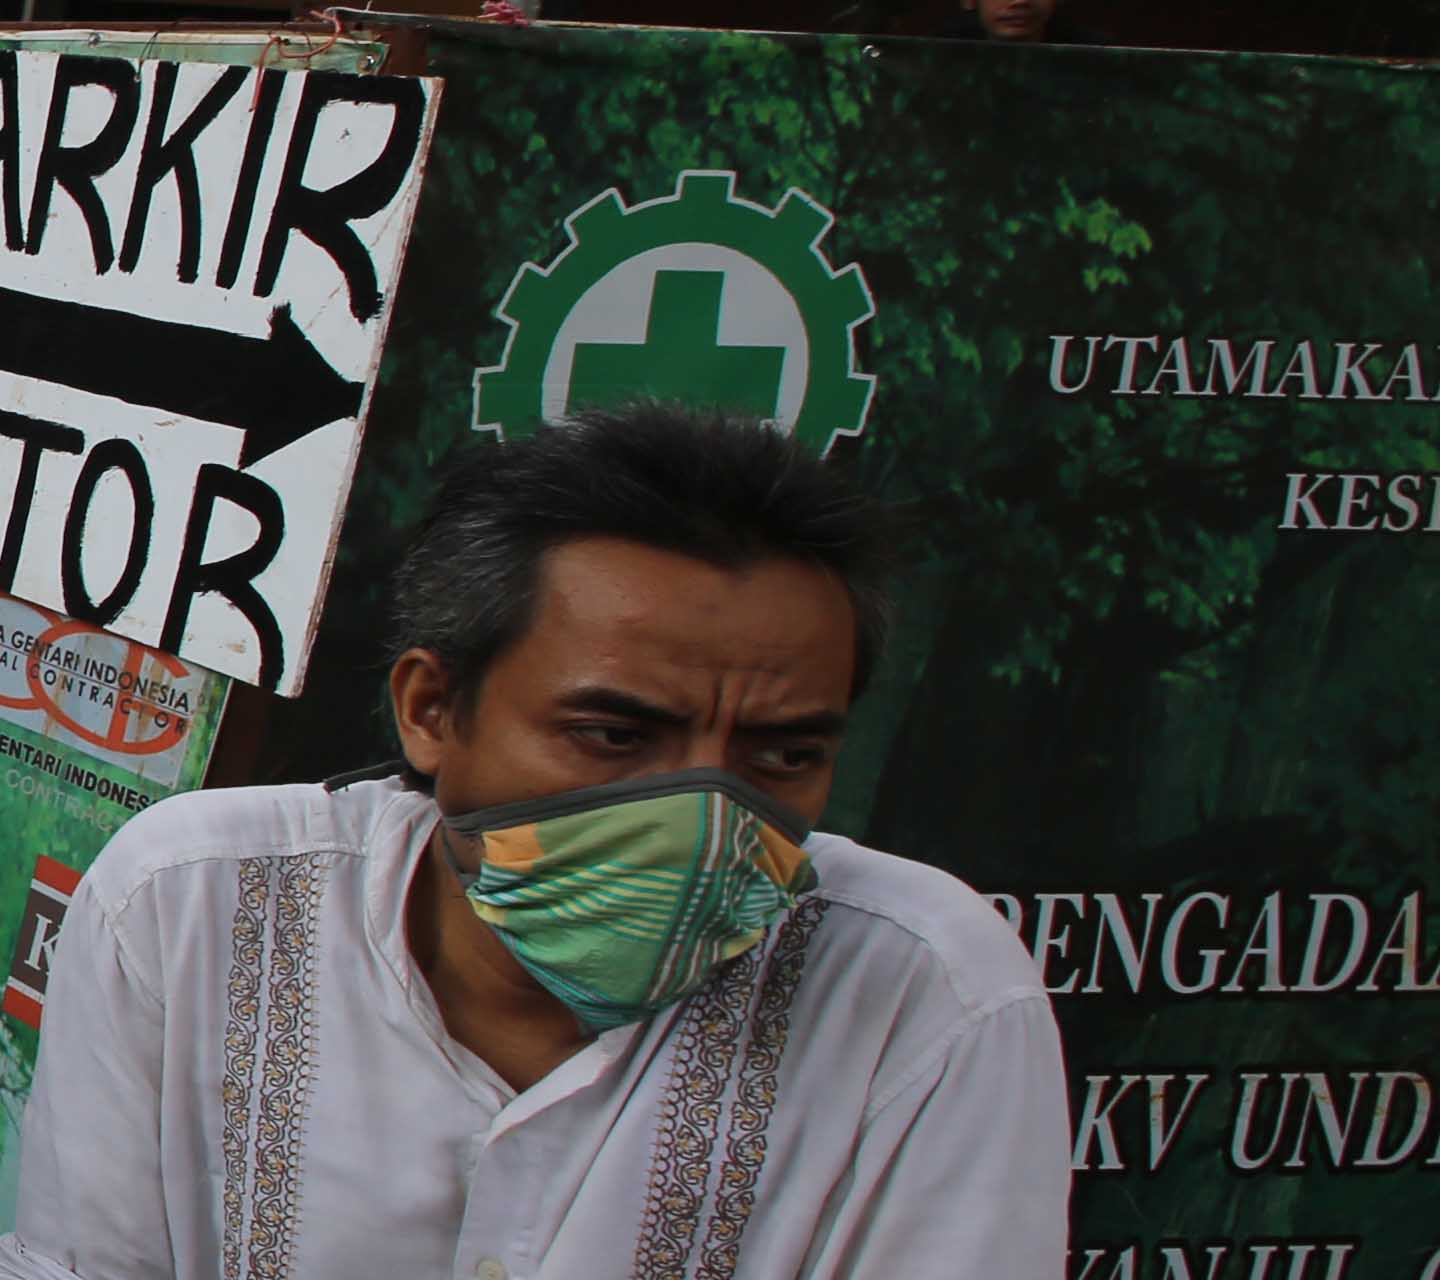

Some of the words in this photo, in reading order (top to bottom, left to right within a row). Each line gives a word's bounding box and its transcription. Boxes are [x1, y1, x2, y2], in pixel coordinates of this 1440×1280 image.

[10, 629, 81, 671] GENTARI
[83, 655, 190, 714] INDONESIA
[29, 662, 187, 734] CONTRACTOR
[64, 763, 157, 813] INDONES
[1071, 1073, 1209, 1171] KV
[1229, 1070, 1440, 1172] UND
